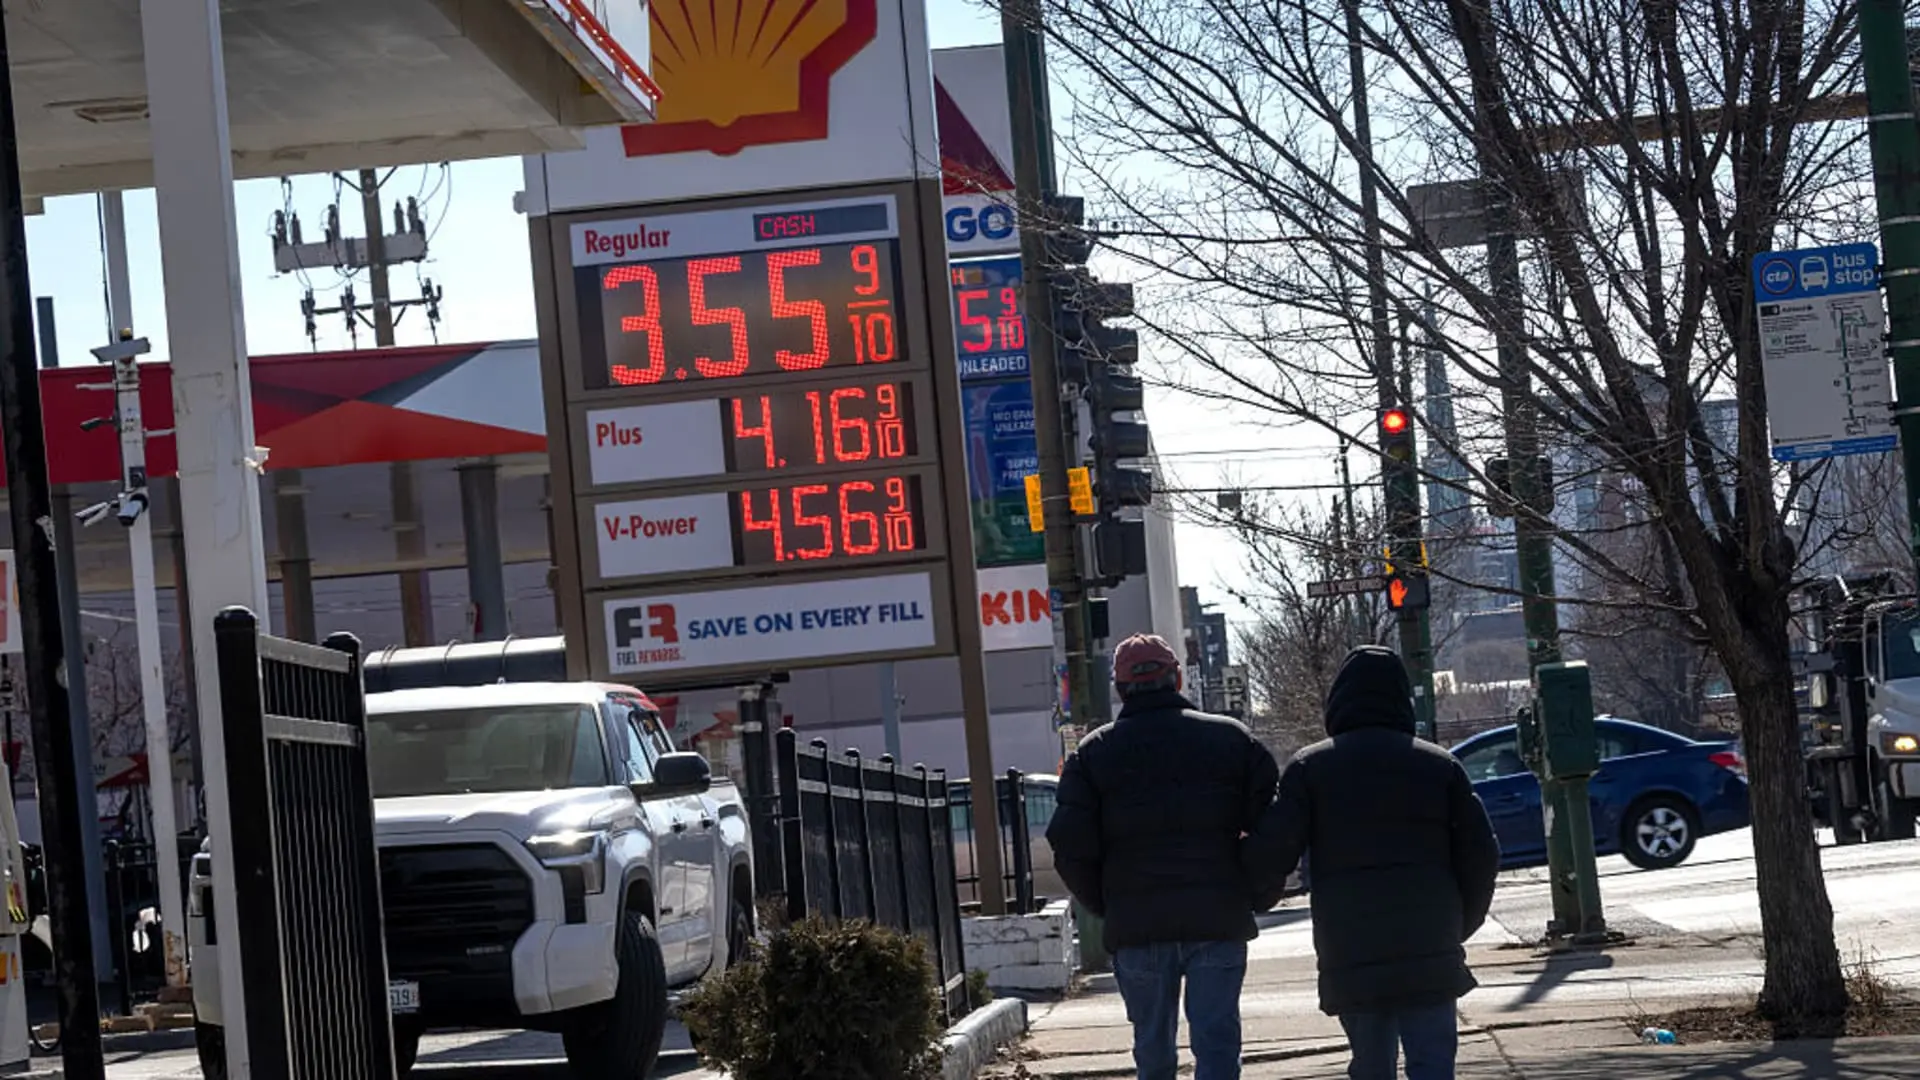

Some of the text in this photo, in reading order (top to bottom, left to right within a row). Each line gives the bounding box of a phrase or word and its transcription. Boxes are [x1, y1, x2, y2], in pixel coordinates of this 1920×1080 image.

[759, 215, 816, 239] CASH
[945, 204, 1014, 242] GO
[584, 224, 670, 258] Regular
[1833, 253, 1866, 268] bus
[1835, 266, 1875, 286] stop
[603, 248, 830, 385] 3.55
[595, 421, 643, 447] Plus
[732, 387, 872, 469] 4.16
[603, 514, 698, 541] V-Power
[742, 480, 880, 562] 4.56
[688, 601, 924, 640] SAVE ON EVERY FILL
[981, 588, 1050, 626] KIN
[616, 651, 637, 666] FUEL
